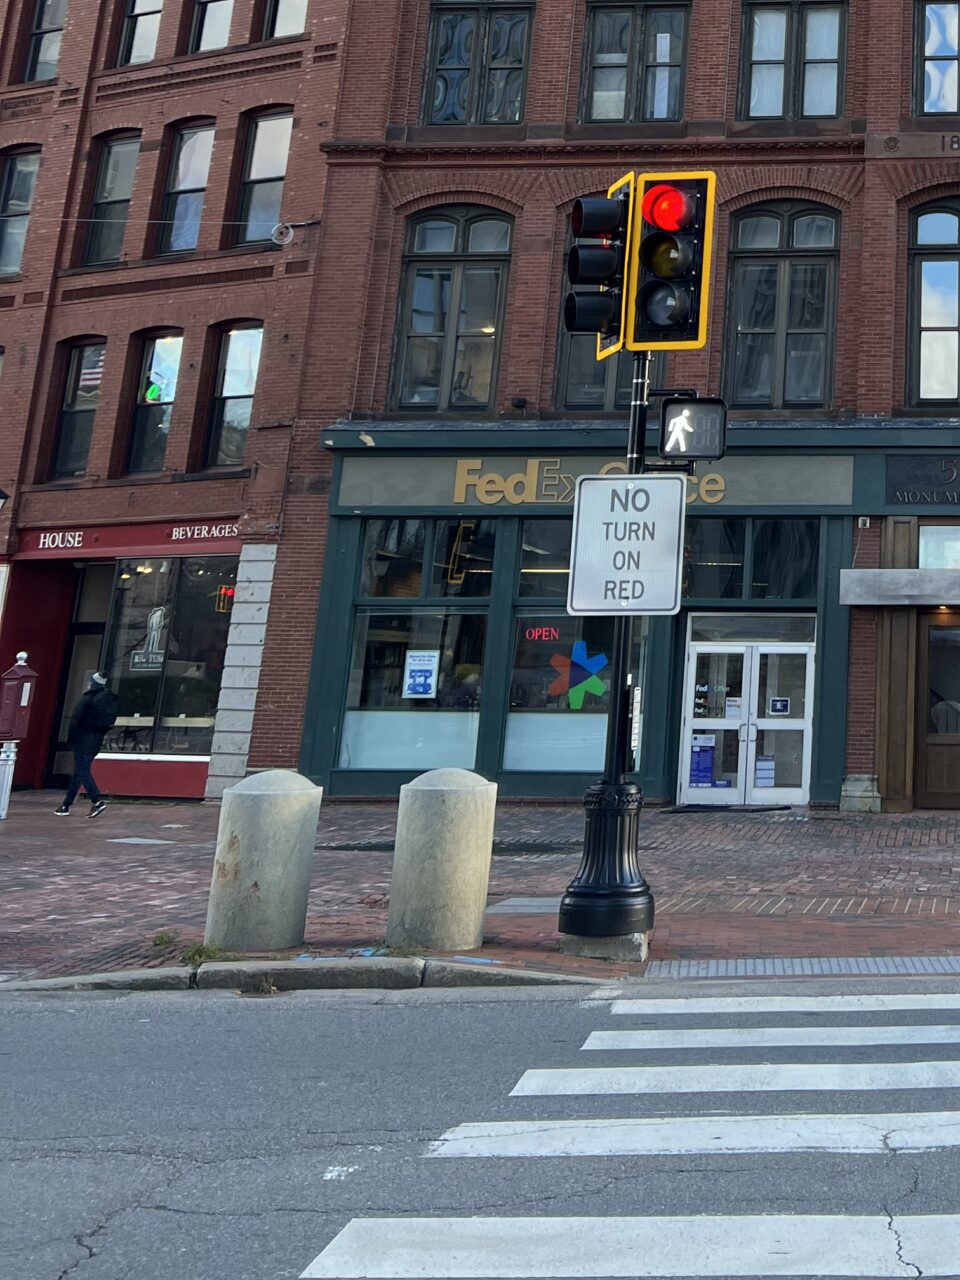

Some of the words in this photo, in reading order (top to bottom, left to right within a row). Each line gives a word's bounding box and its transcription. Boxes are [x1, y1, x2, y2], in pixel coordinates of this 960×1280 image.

[610, 488, 650, 512] NO
[38, 531, 84, 549] HOUSE
[171, 524, 239, 540] BEVERAGES
[602, 522, 656, 541] TURN
[612, 550, 641, 570] ON
[603, 580, 645, 600] RED
[525, 627, 559, 640] OPEN
